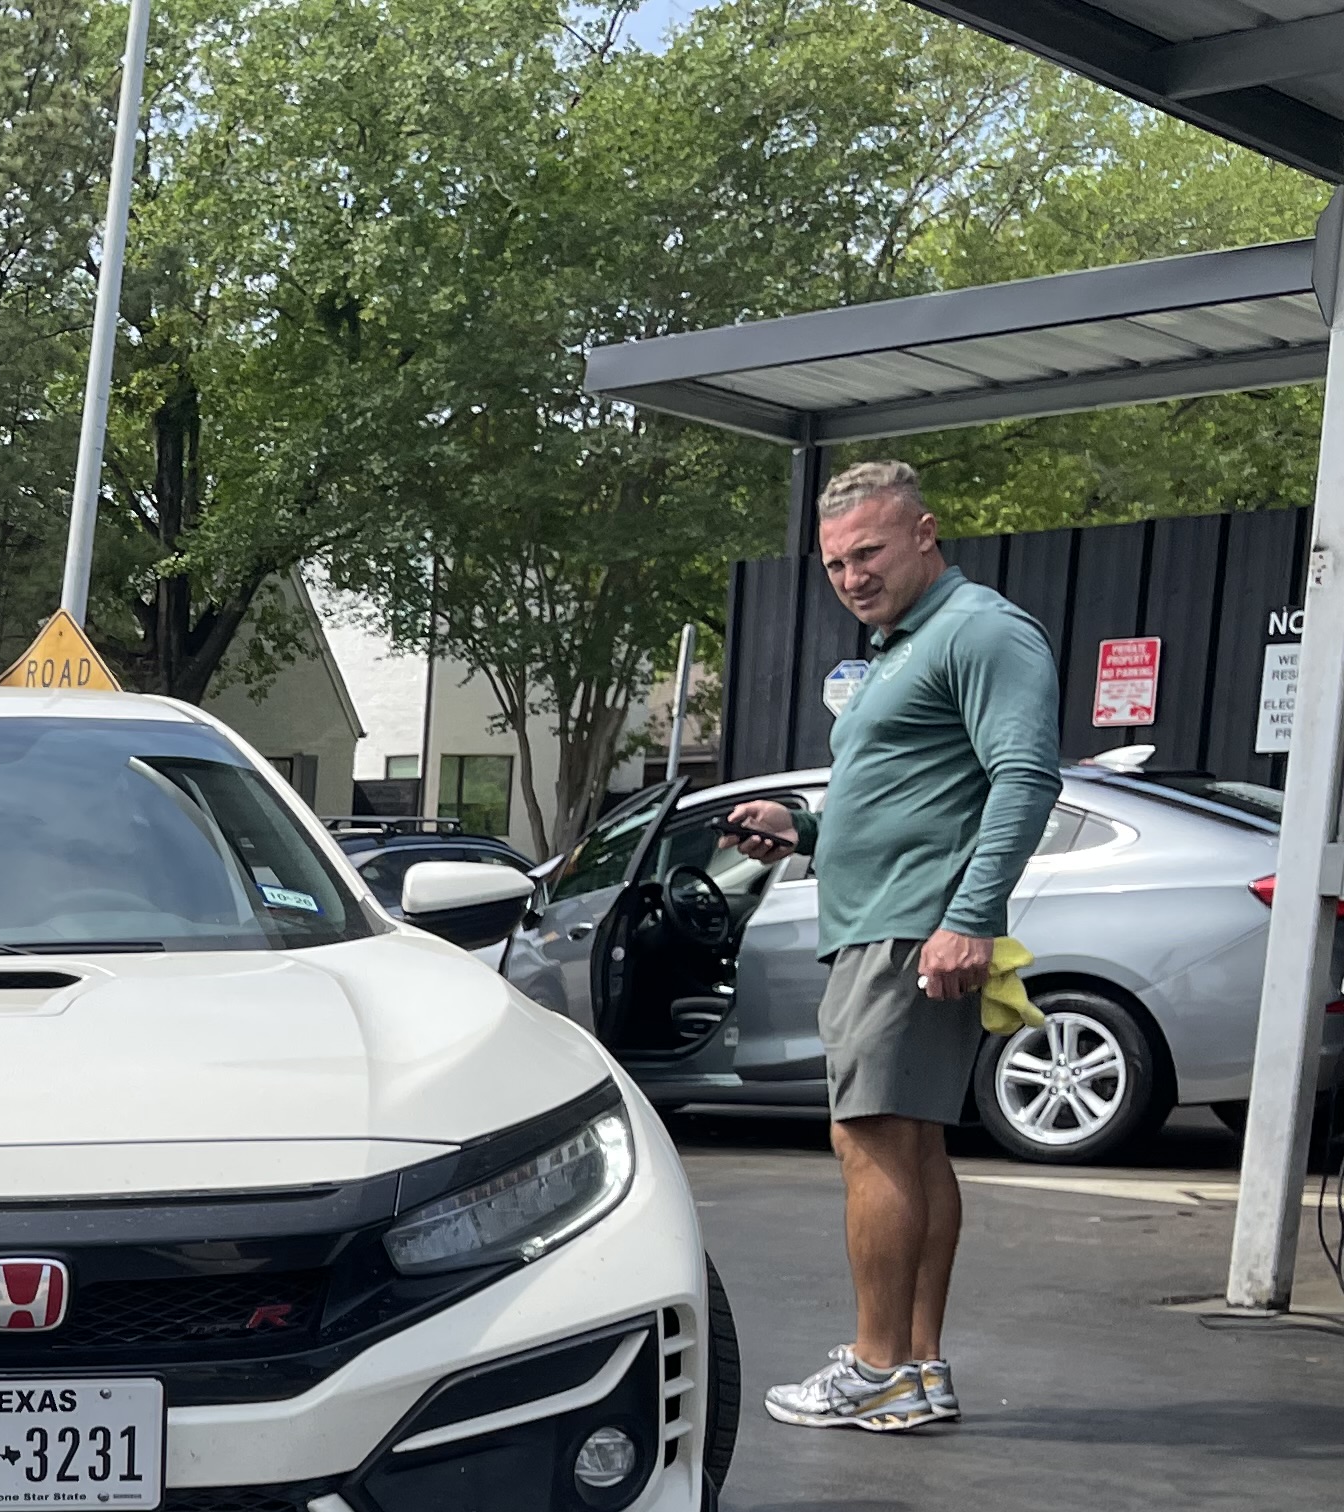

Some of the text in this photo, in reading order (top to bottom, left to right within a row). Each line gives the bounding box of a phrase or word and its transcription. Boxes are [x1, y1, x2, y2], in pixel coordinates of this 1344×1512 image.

[1106, 654, 1151, 666] PROPERTY
[25, 657, 91, 688] ROAD
[1102, 665, 1154, 679] NO PARKING
[1272, 669, 1299, 681] RES
[23, 1493, 50, 1501] Star
[53, 1492, 87, 1501] State
